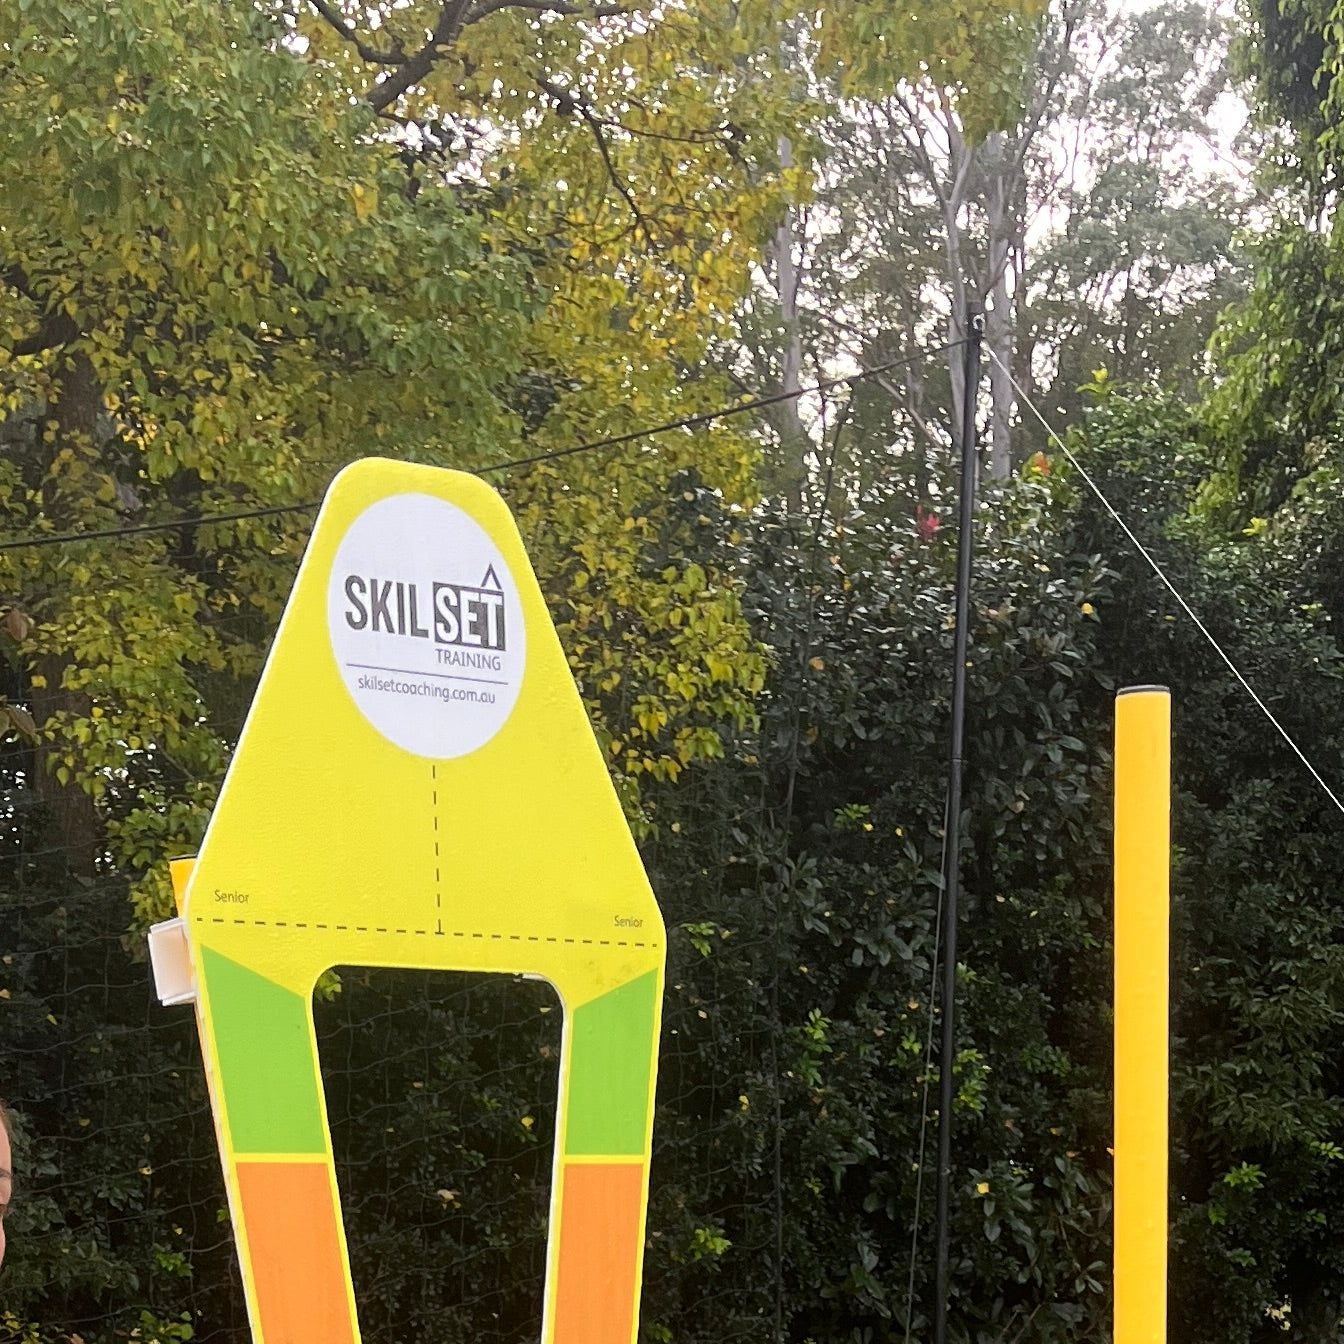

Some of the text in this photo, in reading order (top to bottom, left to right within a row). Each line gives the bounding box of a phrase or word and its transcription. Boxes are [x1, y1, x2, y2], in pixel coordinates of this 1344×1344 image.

[434, 648, 502, 671] TRAINING
[357, 674, 497, 704] skilsetcoaching.com.au
[214, 889, 250, 904] Senior
[614, 914, 644, 928] Senior
